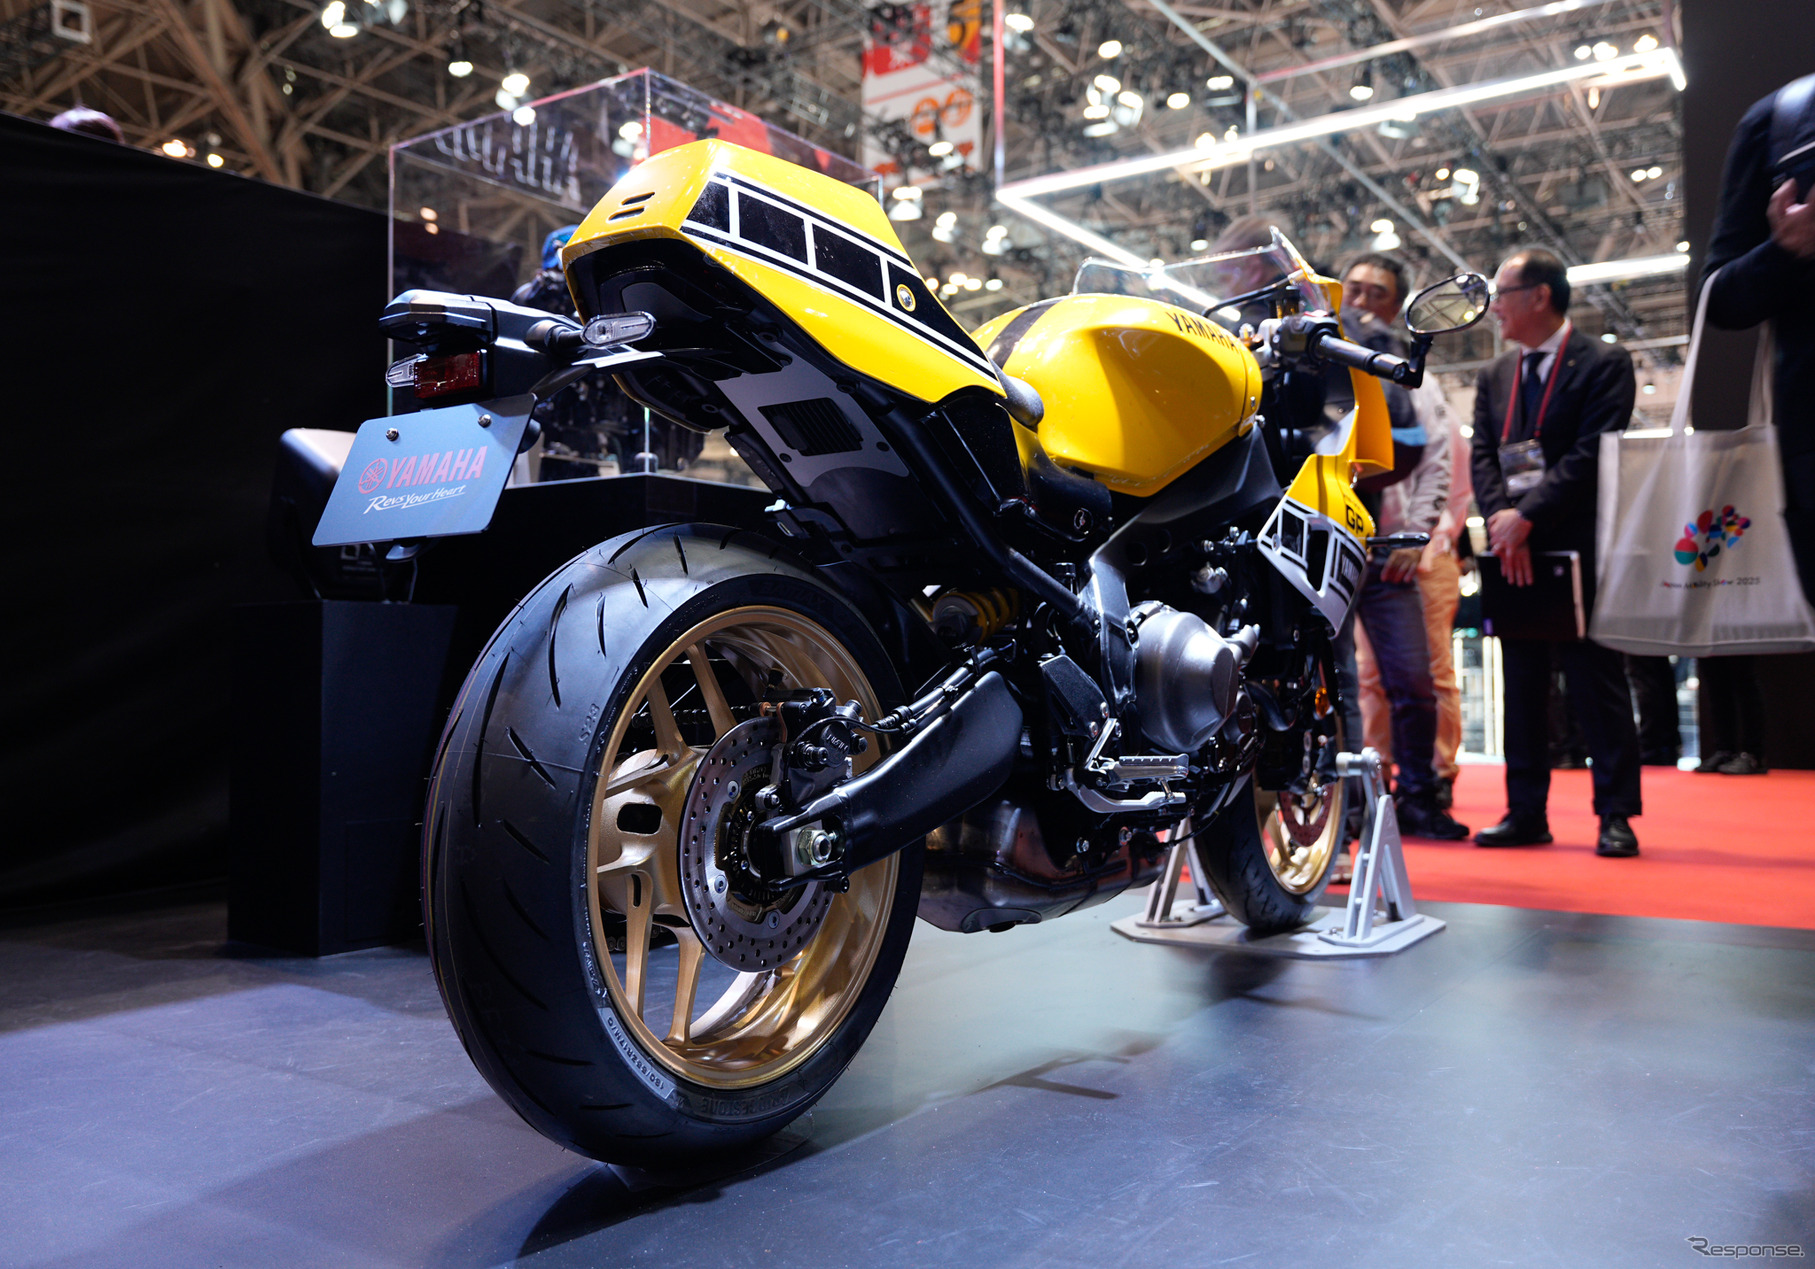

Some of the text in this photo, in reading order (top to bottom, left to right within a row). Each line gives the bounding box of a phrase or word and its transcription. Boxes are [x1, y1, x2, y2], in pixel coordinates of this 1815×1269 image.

[1165, 311, 1240, 354] YAMAHA
[386, 445, 488, 489] YAMAHA
[1345, 504, 1364, 534] GP
